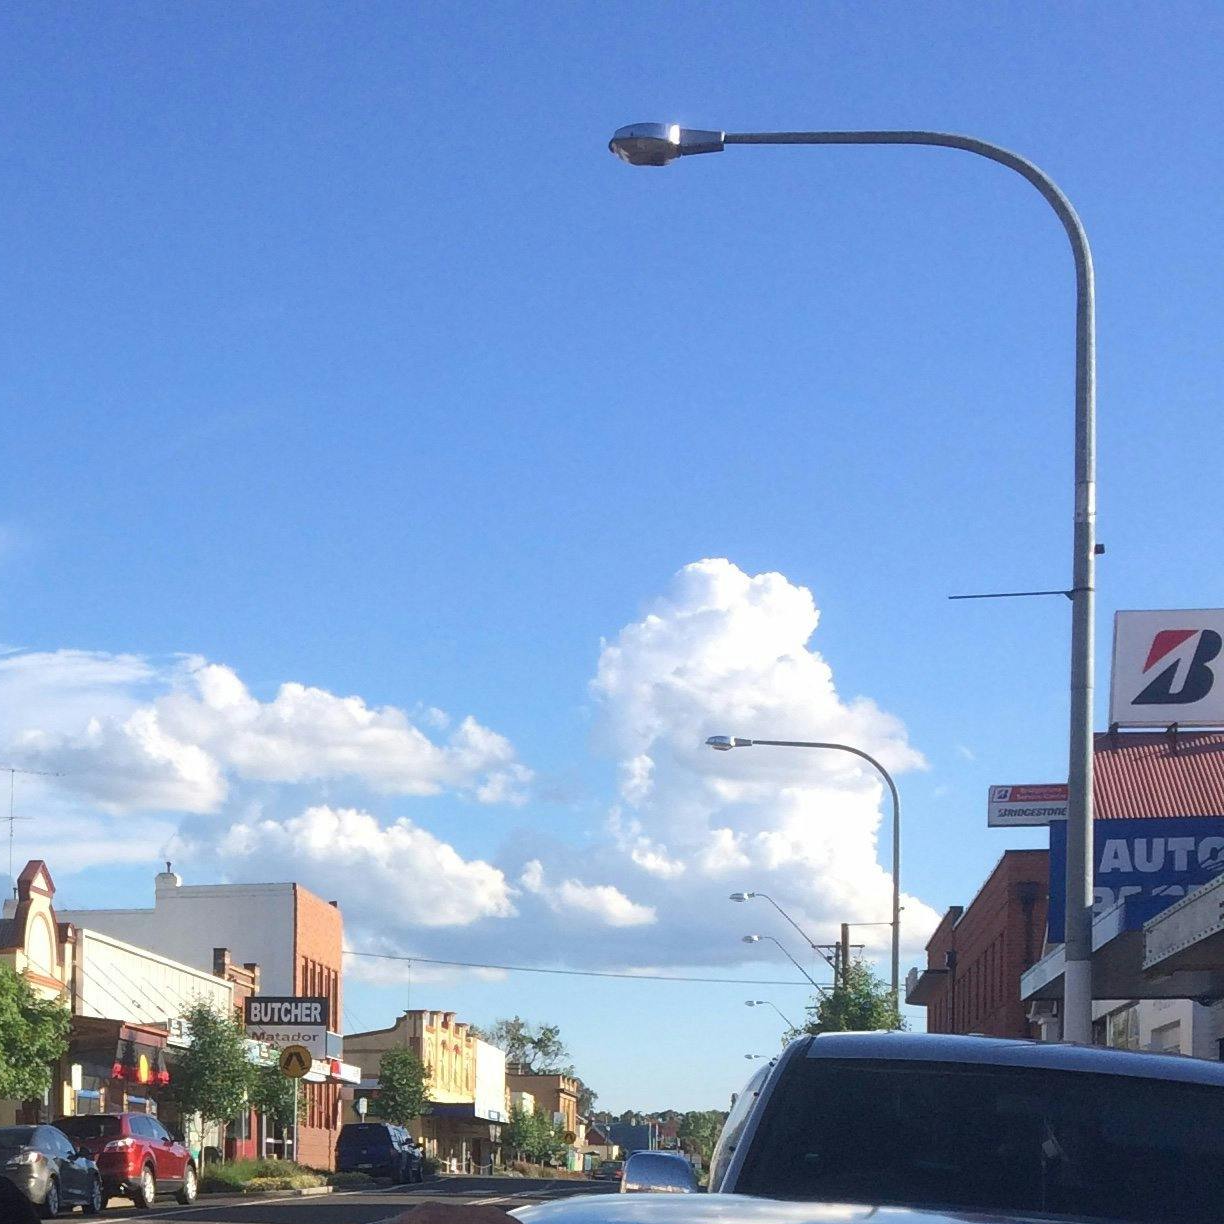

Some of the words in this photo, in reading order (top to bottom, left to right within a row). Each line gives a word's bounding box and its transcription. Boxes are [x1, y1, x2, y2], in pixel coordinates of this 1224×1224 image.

[997, 807, 1067, 817] BRIDGESTONE
[250, 1002, 322, 1023] BUTCHER
[251, 1031, 320, 1042] Matador
